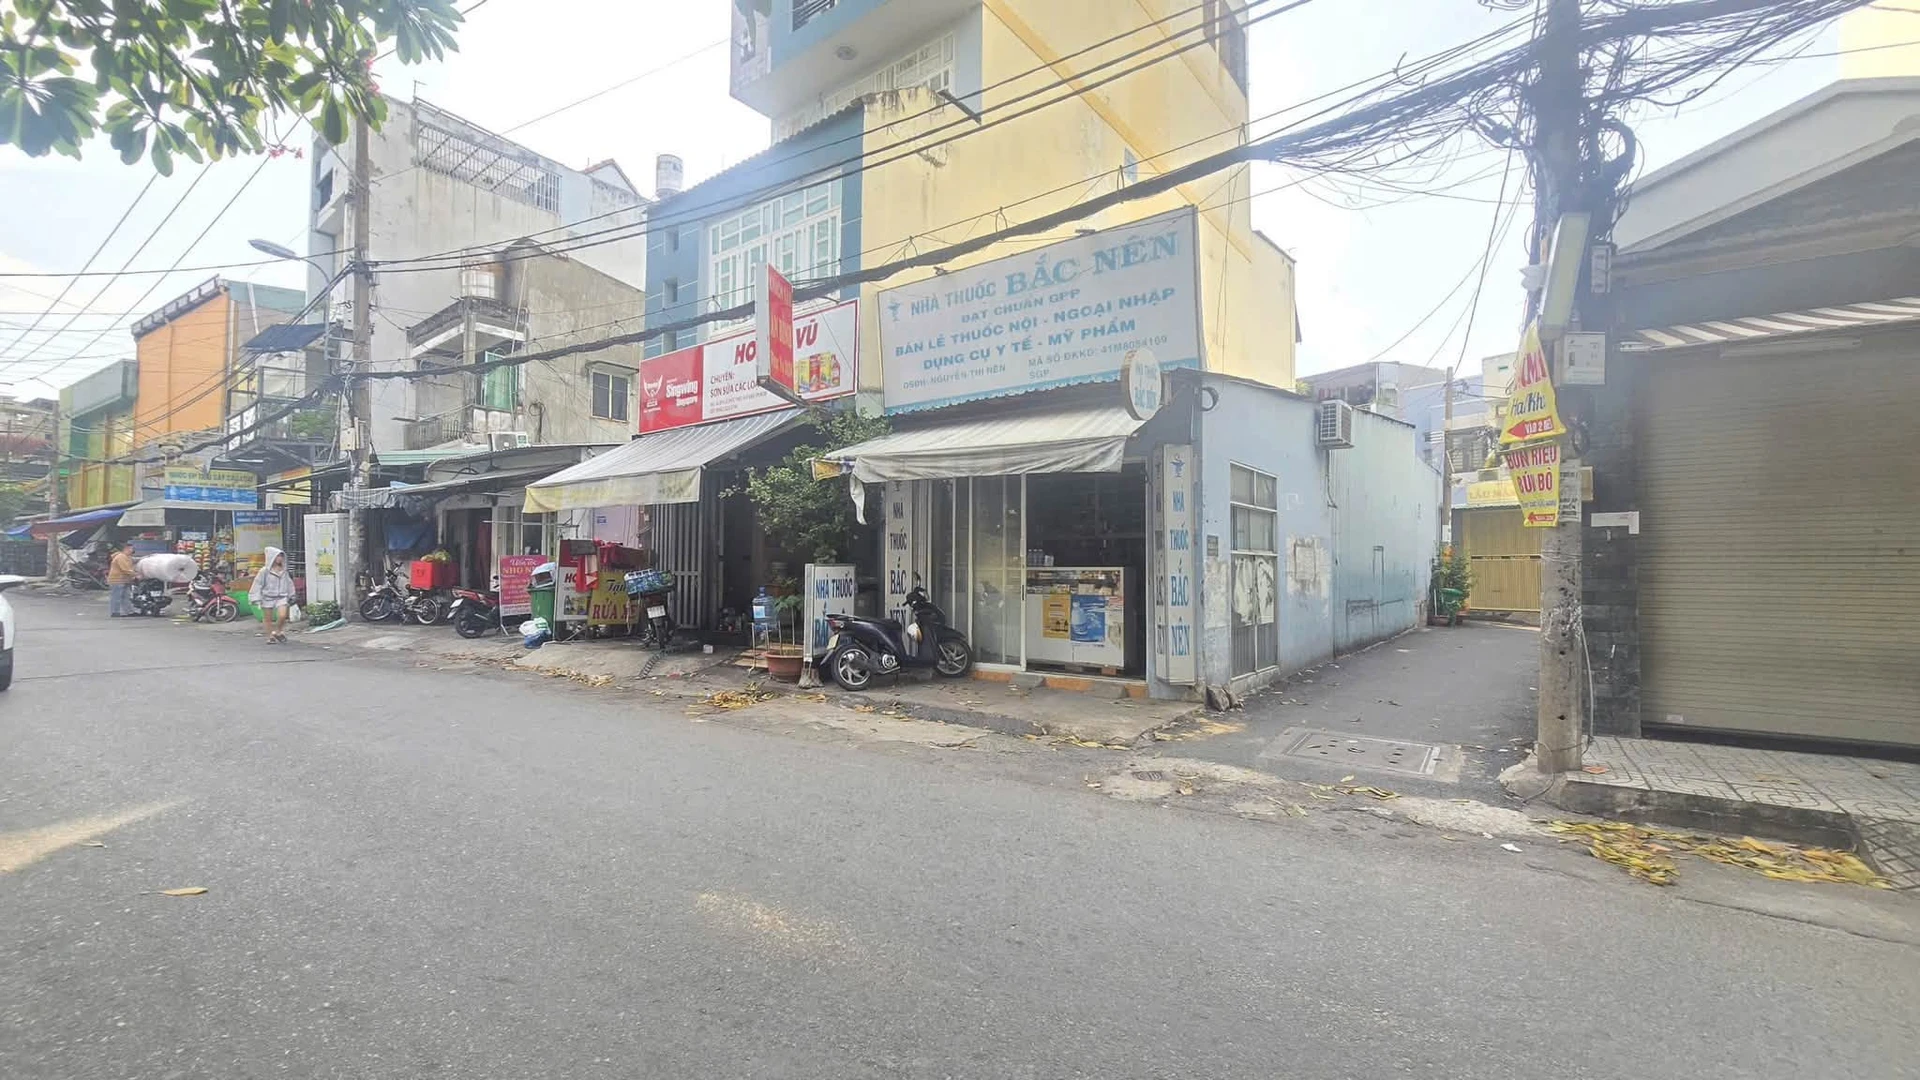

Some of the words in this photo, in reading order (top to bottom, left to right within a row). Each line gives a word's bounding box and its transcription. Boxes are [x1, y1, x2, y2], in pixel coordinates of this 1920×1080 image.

[911, 293, 939, 316] NHÀ
[945, 279, 996, 308] THUỐC
[1005, 253, 1080, 295] BẮC
[1092, 231, 1178, 275] NÊN
[1050, 289, 1080, 303] GPP
[895, 341, 924, 357] BÁN
[928, 334, 945, 349] LẺ
[950, 322, 1004, 344] THUỐC
[1009, 316, 1037, 333] NỘI
[1054, 301, 1112, 323] NGOẠI
[1119, 287, 1175, 309] NHẬP
[734, 340, 757, 365] HO
[795, 320, 818, 349] VŨ
[923, 353, 965, 370] DỤNG
[969, 347, 991, 361] CỤ
[996, 344, 1006, 356] Y
[1011, 335, 1033, 352] TẾ
[1048, 328, 1074, 346] MỸ
[1081, 316, 1136, 340] PHẨM
[1537, 466, 1553, 491] BÒ
[1173, 485, 1185, 512] NHÀ
[890, 526, 907, 550] THUỐC
[1170, 521, 1188, 550] THUỐC
[815, 573, 829, 600] NHÀ
[831, 570, 853, 599] THUỐC
[890, 556, 907, 594] BẮC
[1171, 557, 1189, 606] BẮC
[593, 599, 617, 619] RỬA
